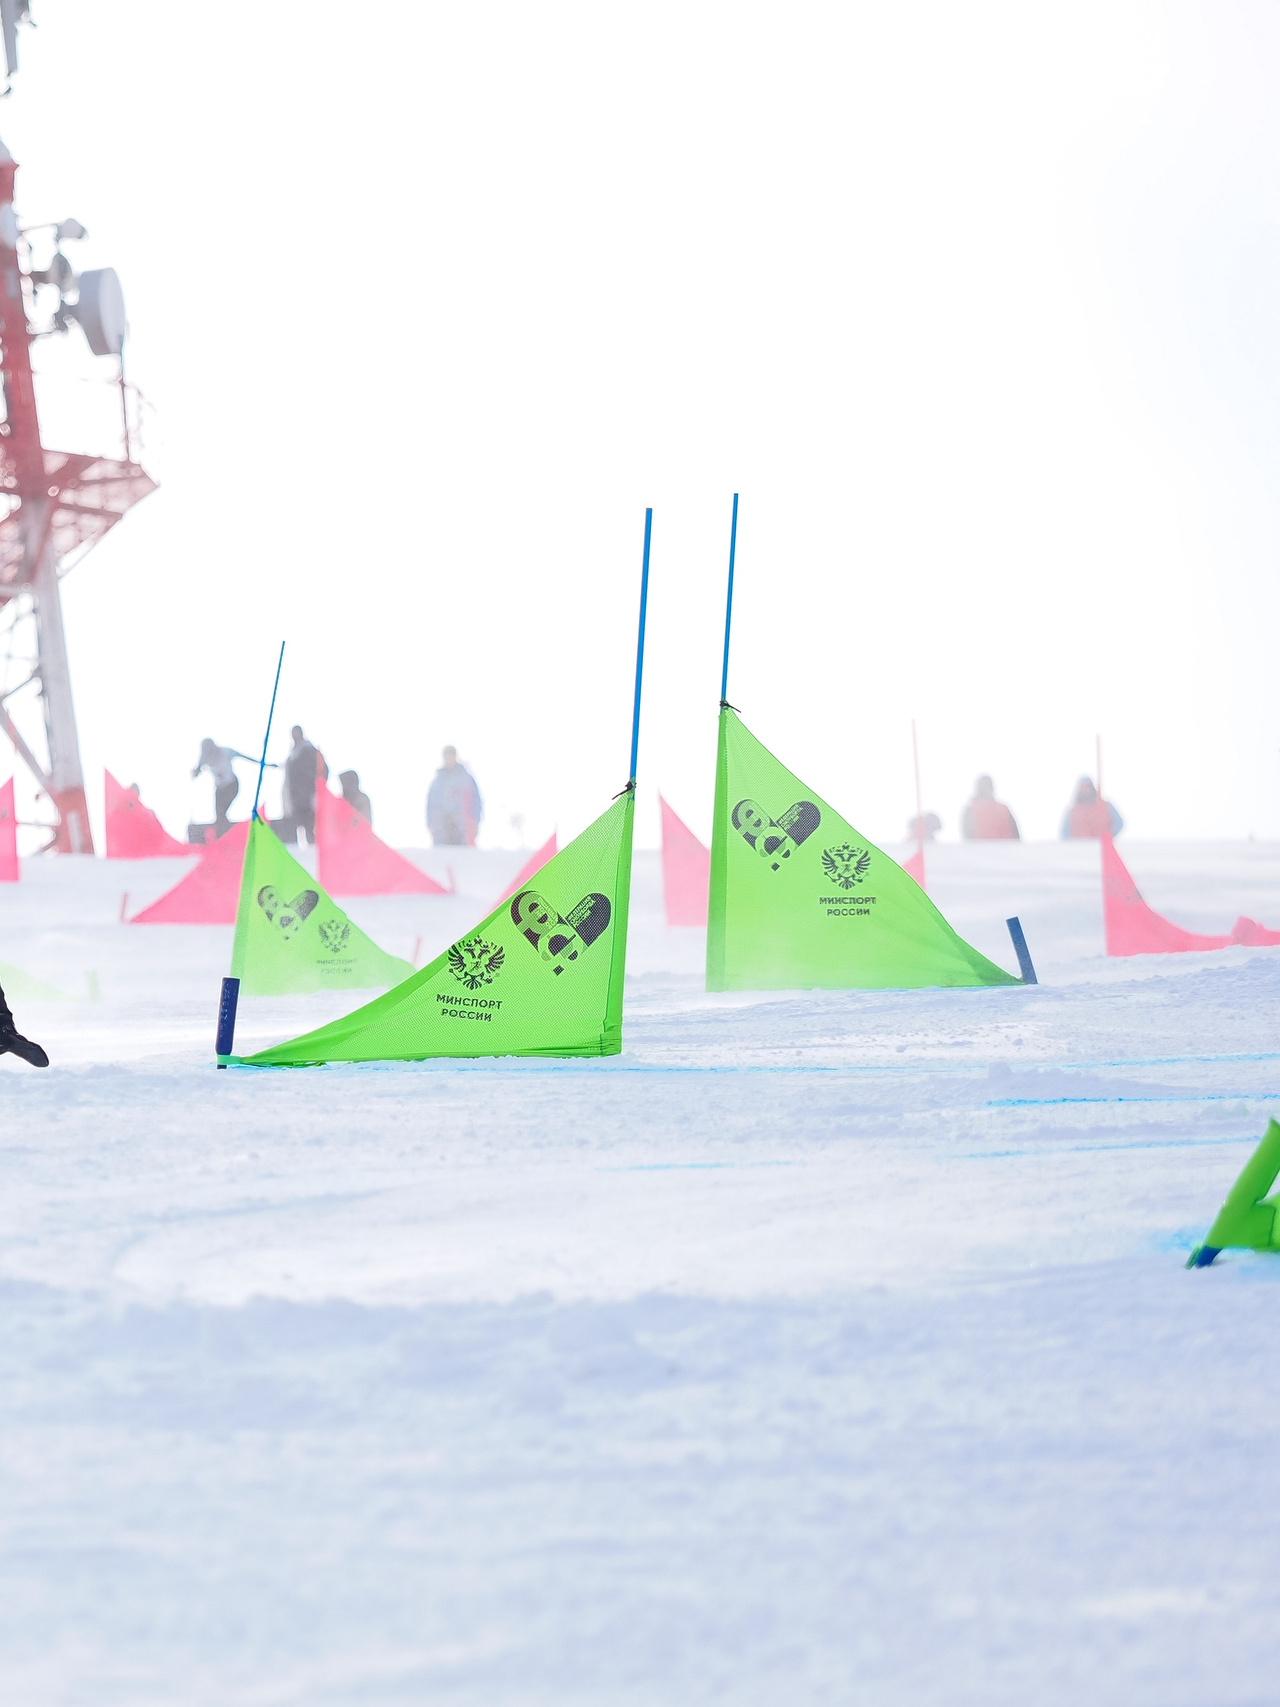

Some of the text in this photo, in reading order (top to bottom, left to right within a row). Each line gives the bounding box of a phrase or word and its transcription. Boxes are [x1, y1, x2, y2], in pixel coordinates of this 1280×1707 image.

[819, 896, 877, 905] МИНСПОРТ
[826, 908, 871, 917] РОССИИ
[436, 993, 503, 1010] МИНСПОРТ
[441, 1008, 492, 1022] РОССИИ
